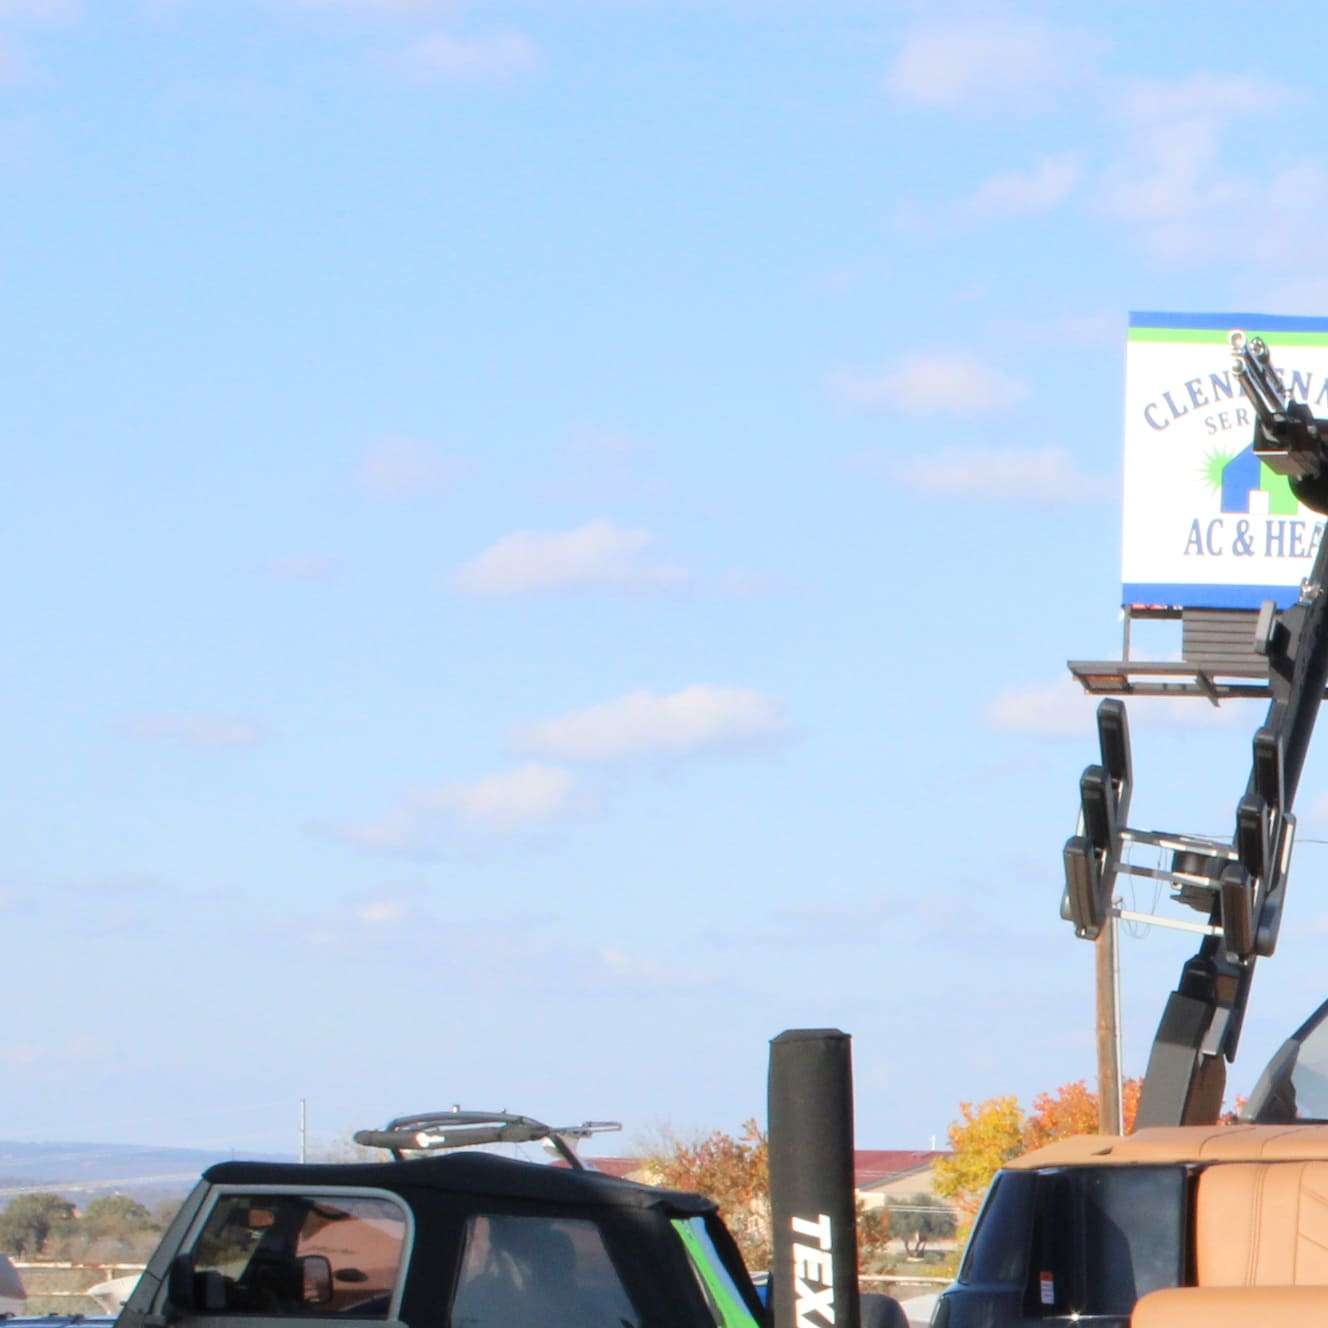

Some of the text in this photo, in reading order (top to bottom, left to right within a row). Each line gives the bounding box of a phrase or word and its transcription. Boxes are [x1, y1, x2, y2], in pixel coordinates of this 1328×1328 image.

[1184, 518, 1327, 558] AC & HEA
